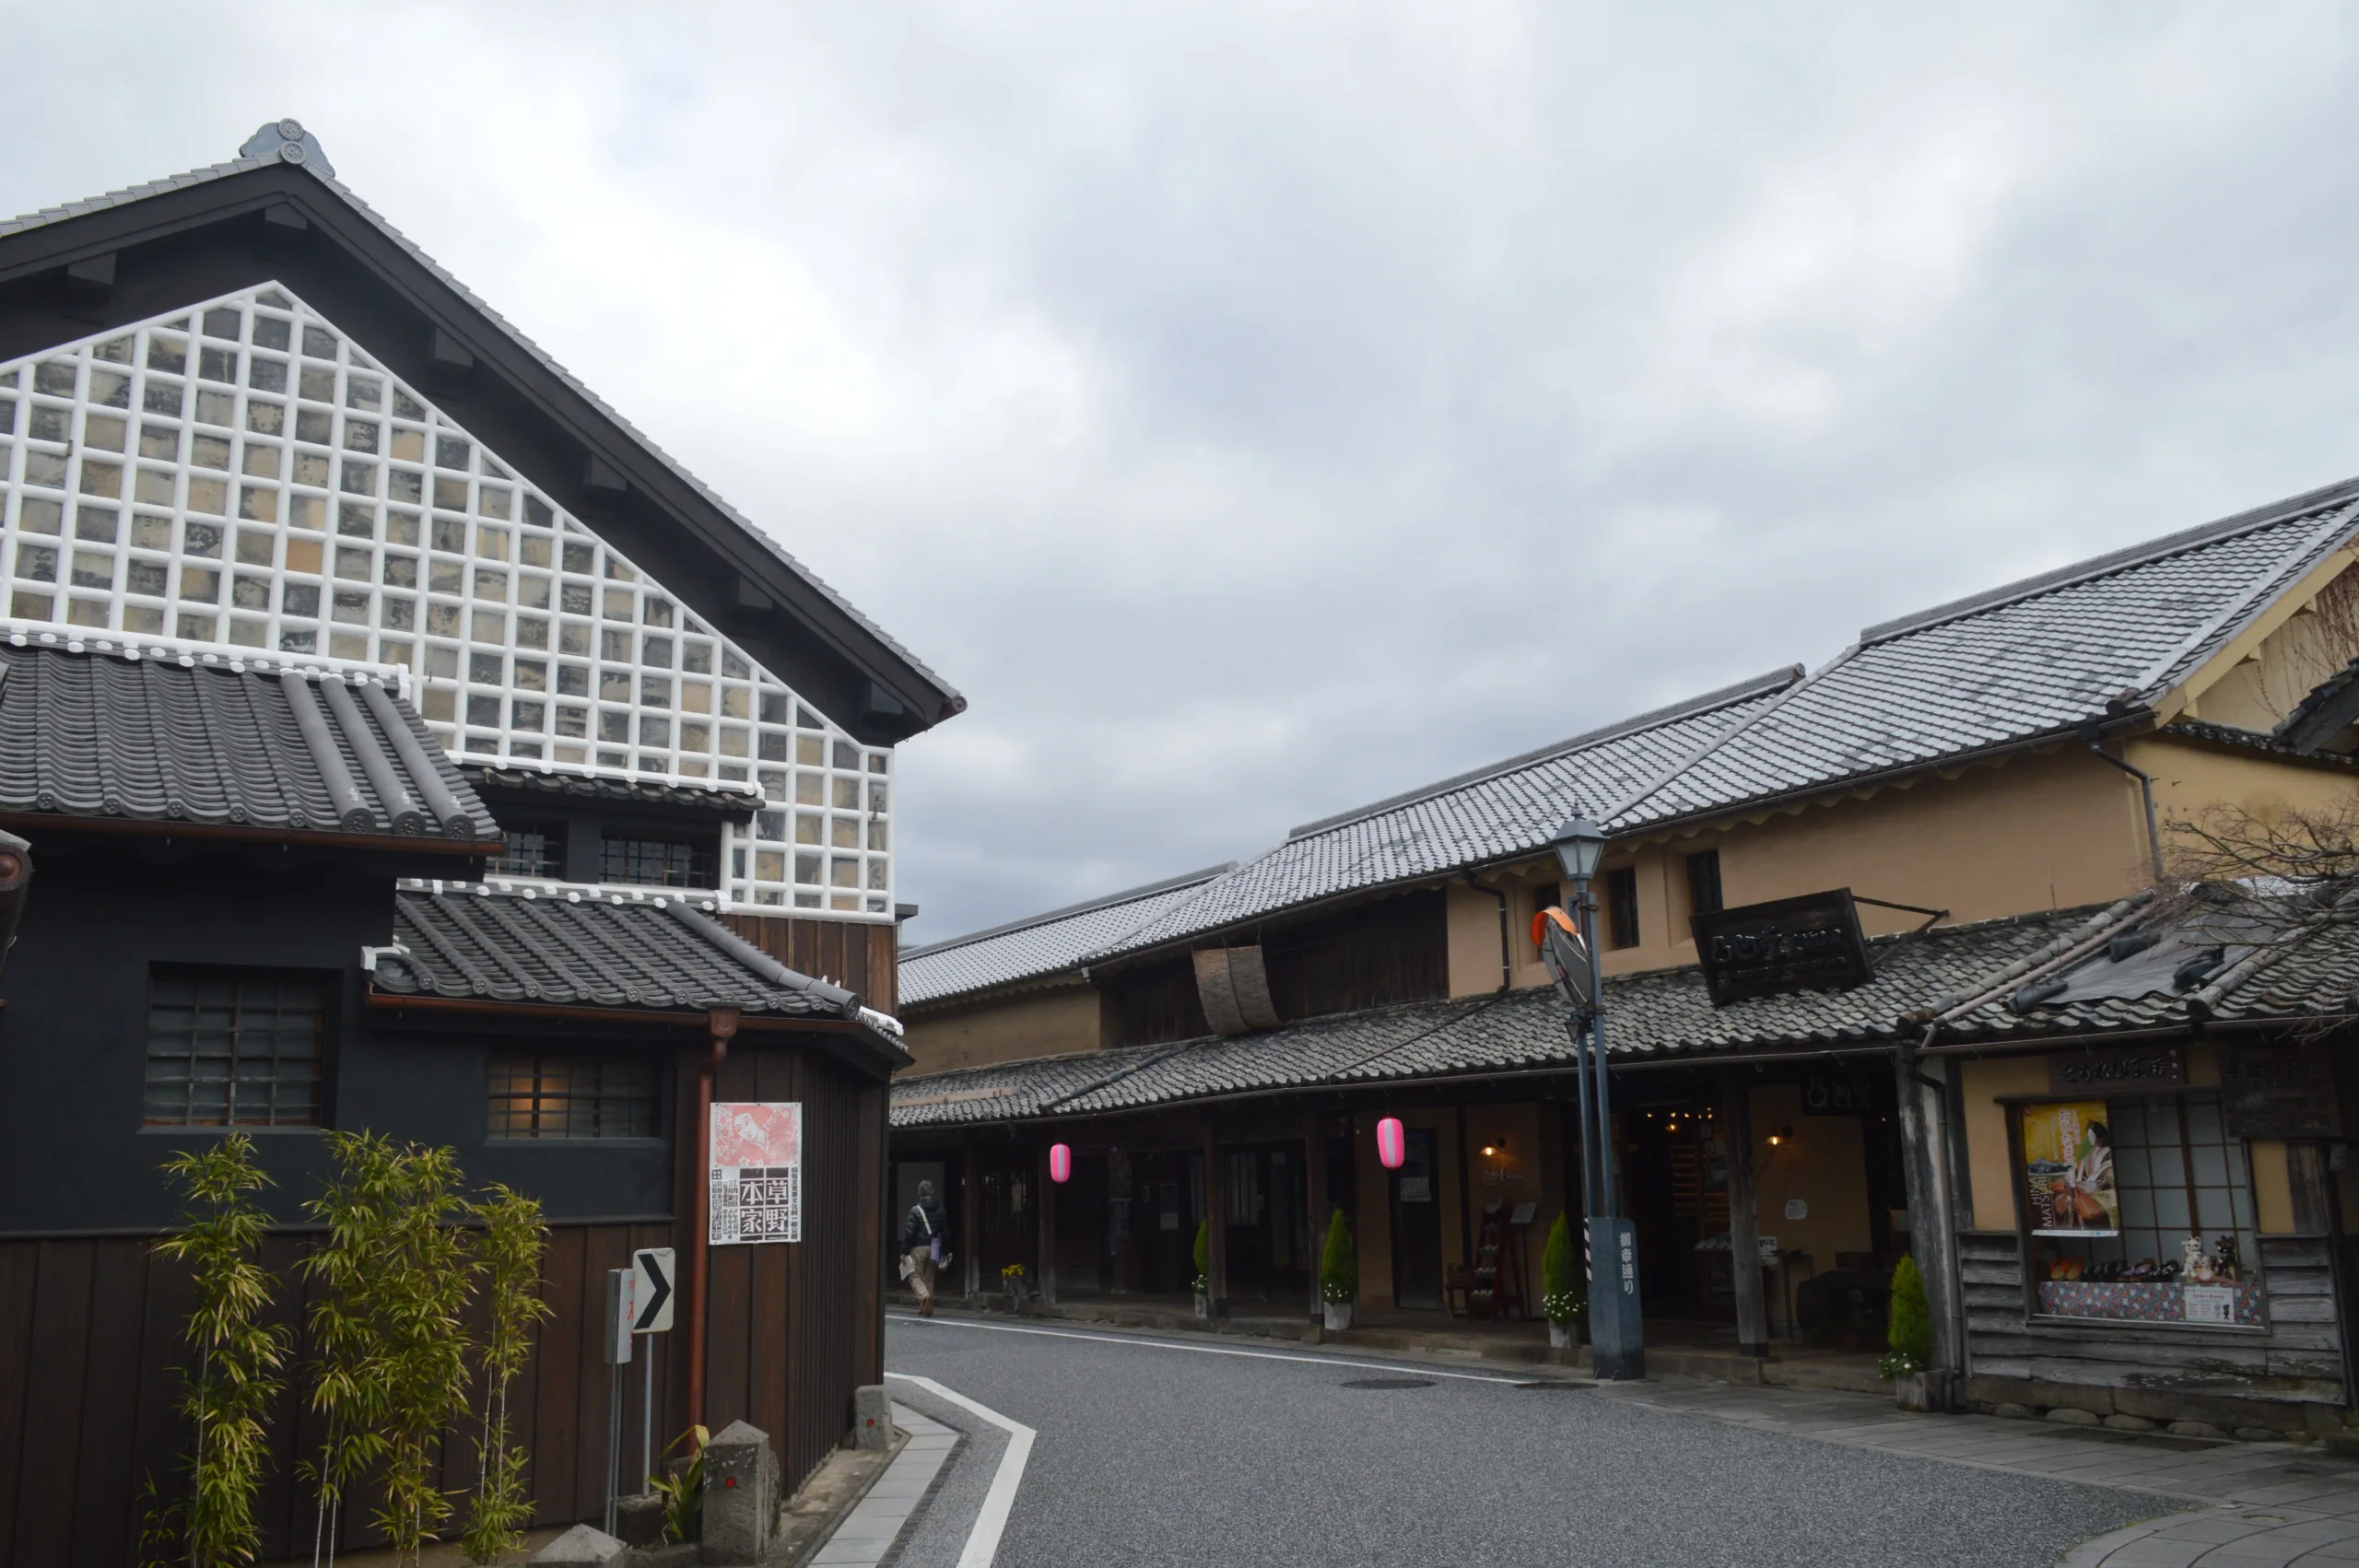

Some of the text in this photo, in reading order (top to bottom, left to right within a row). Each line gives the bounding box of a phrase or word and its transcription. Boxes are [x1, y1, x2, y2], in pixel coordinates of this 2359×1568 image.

[740, 1180, 764, 1234] 本家
[766, 1179, 788, 1233] 草野
[2028, 1176, 2039, 1206] HINA
[2038, 1176, 2054, 1227] MATSURI
[1619, 1232, 1634, 1294] 御幸通り
